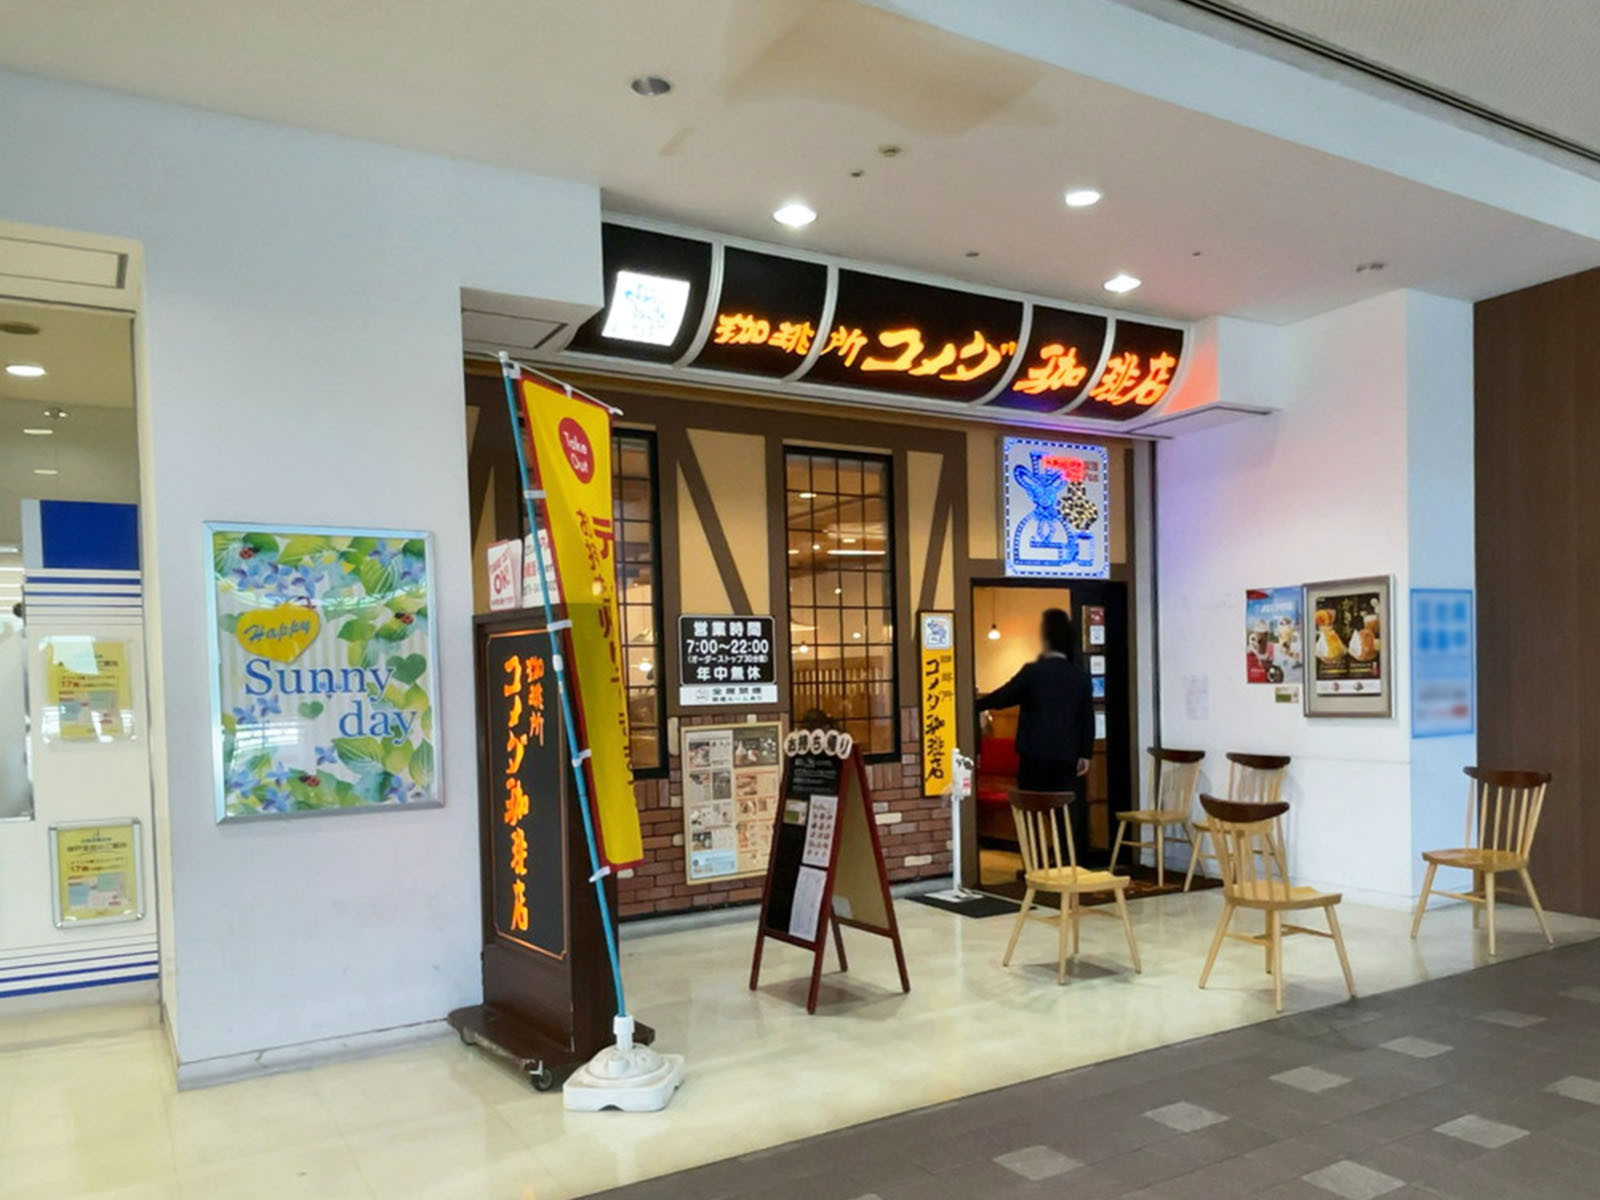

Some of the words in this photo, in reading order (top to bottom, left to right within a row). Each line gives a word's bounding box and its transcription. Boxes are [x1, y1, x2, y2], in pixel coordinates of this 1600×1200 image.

[562, 431, 588, 455] Take
[570, 453, 589, 473] Out
[243, 620, 311, 642] Happy
[693, 620, 762, 637] 営業時間
[244, 658, 395, 701] Sunny
[696, 666, 761, 681] 年中無休
[339, 700, 417, 746] day
